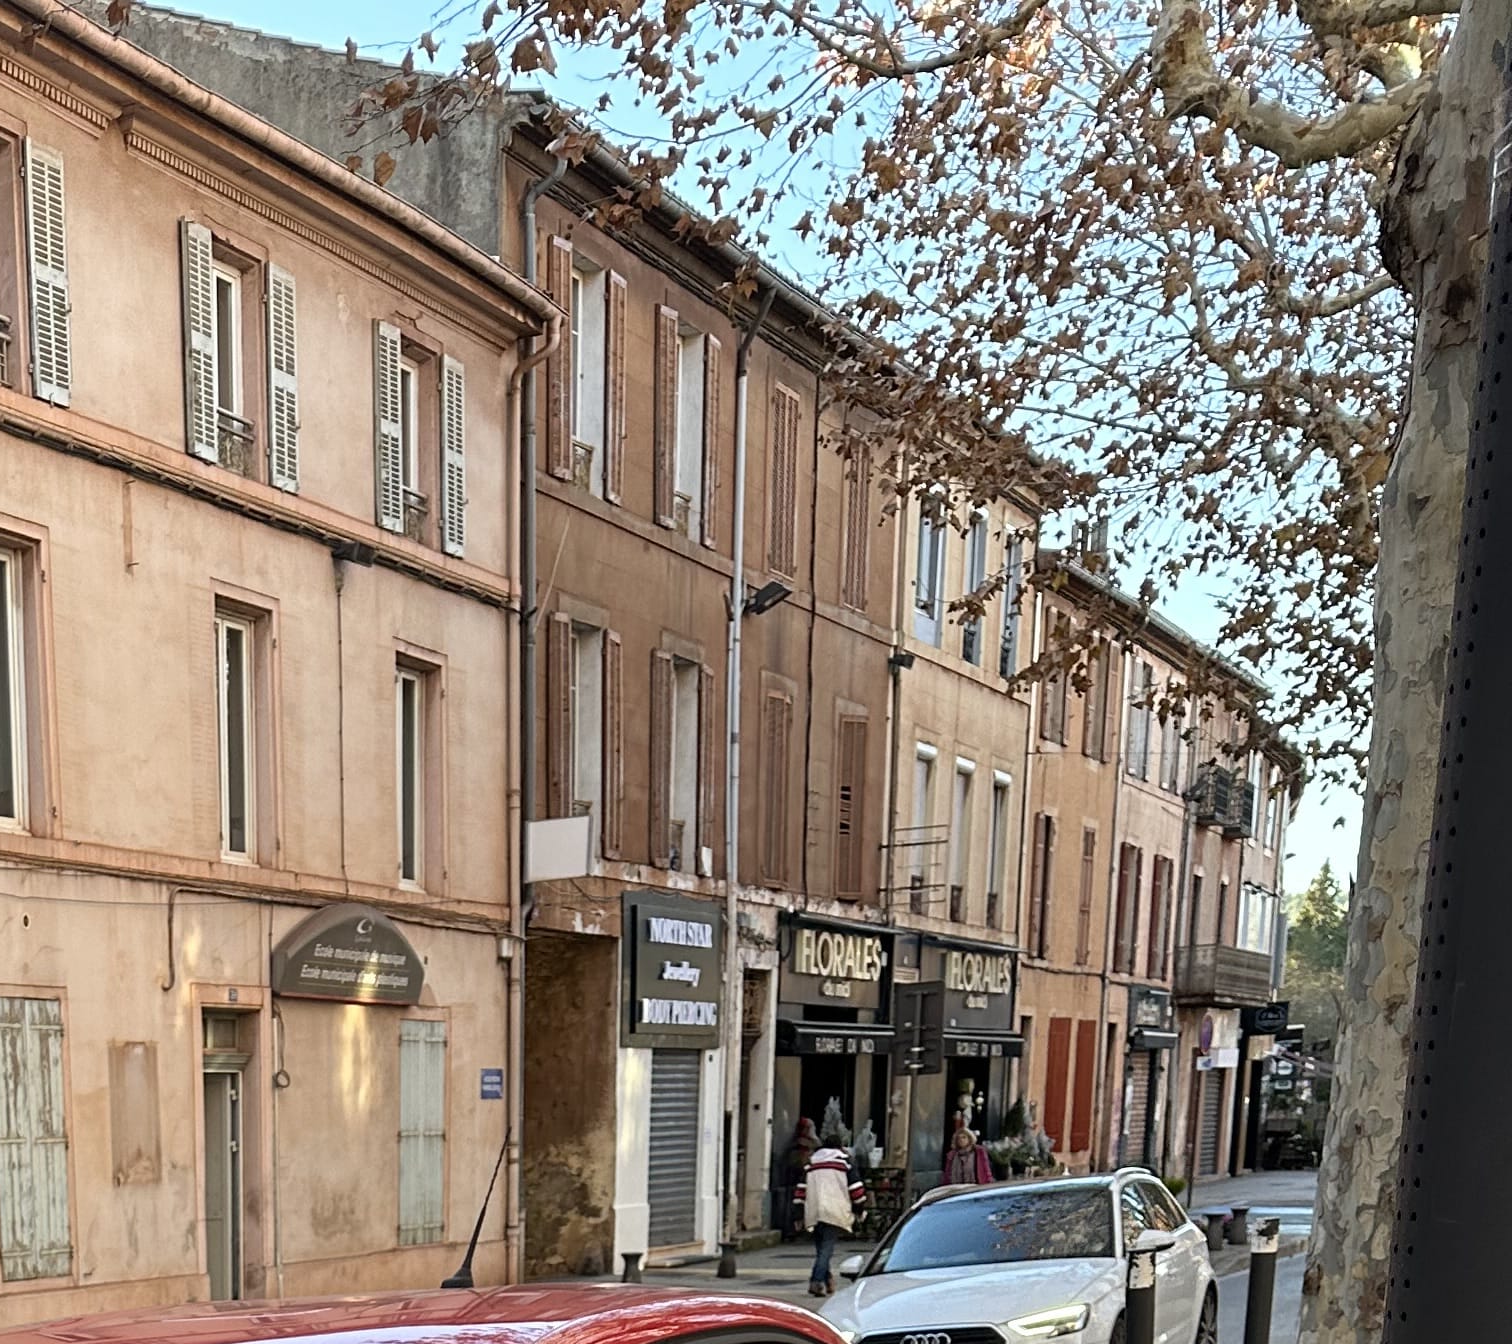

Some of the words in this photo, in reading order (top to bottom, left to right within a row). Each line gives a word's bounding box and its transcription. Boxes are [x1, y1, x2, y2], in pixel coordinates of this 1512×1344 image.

[649, 917, 687, 946] NORTH
[687, 921, 713, 949] STAR
[795, 928, 882, 982] FLORALES
[945, 951, 1012, 995] FLORALES
